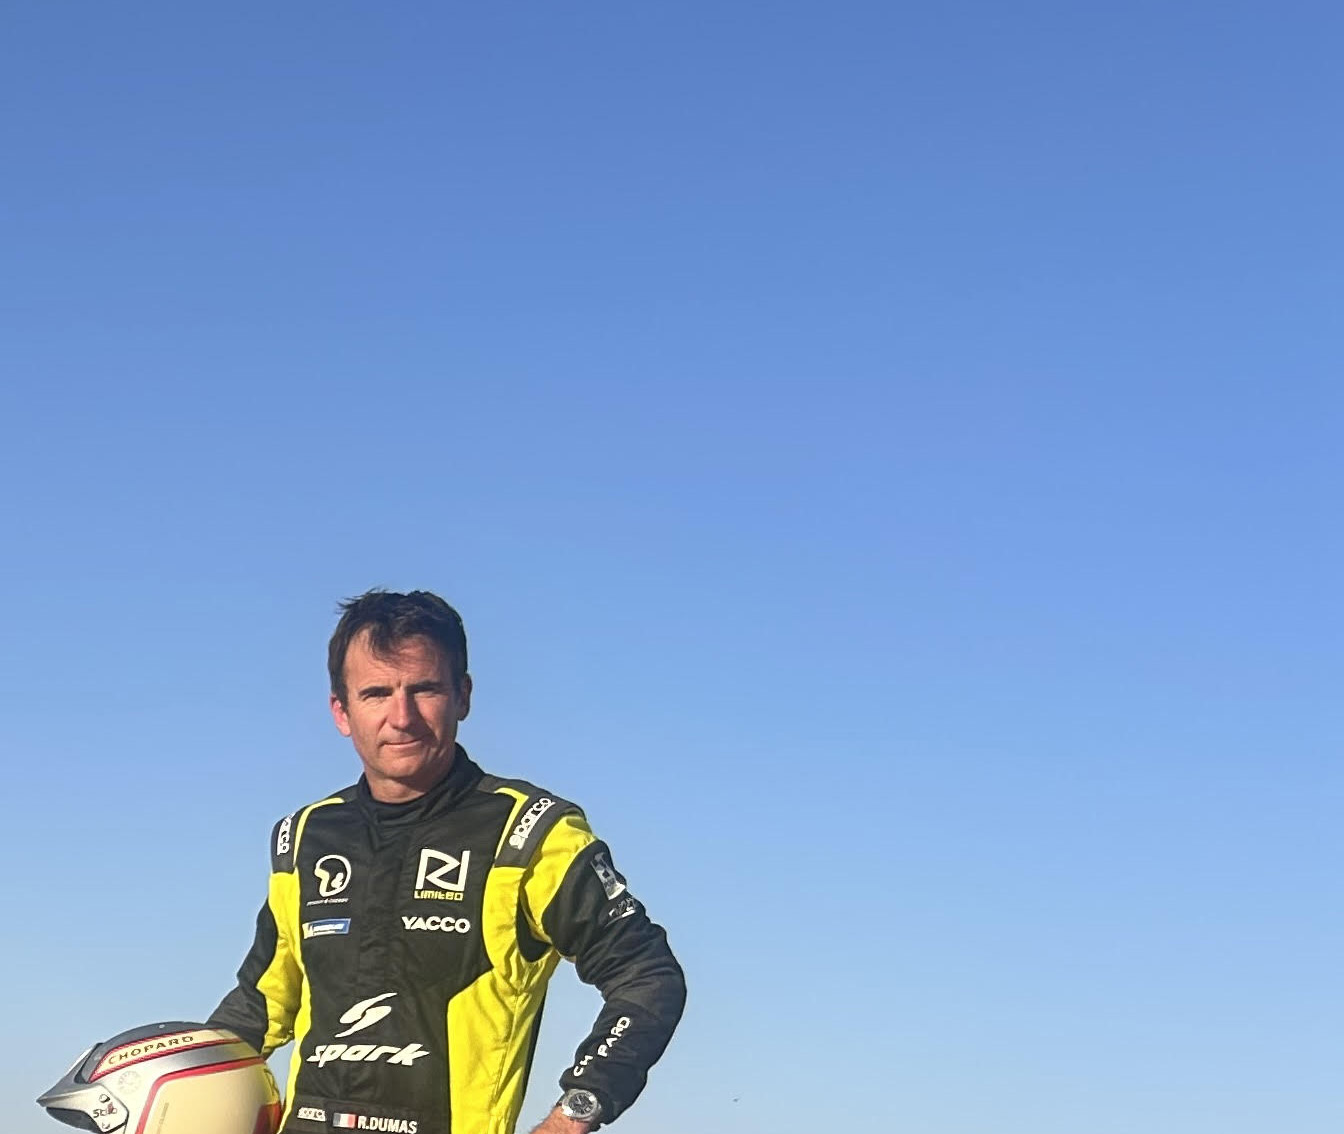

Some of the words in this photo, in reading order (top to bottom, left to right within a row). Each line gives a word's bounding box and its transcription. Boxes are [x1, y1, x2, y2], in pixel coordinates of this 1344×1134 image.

[508, 797, 556, 850] sparco
[401, 916, 471, 934] YACCO
[107, 1036, 194, 1065] CHOPARD
[306, 1043, 430, 1068] spark
[357, 1115, 418, 1134] R.DUMAS
